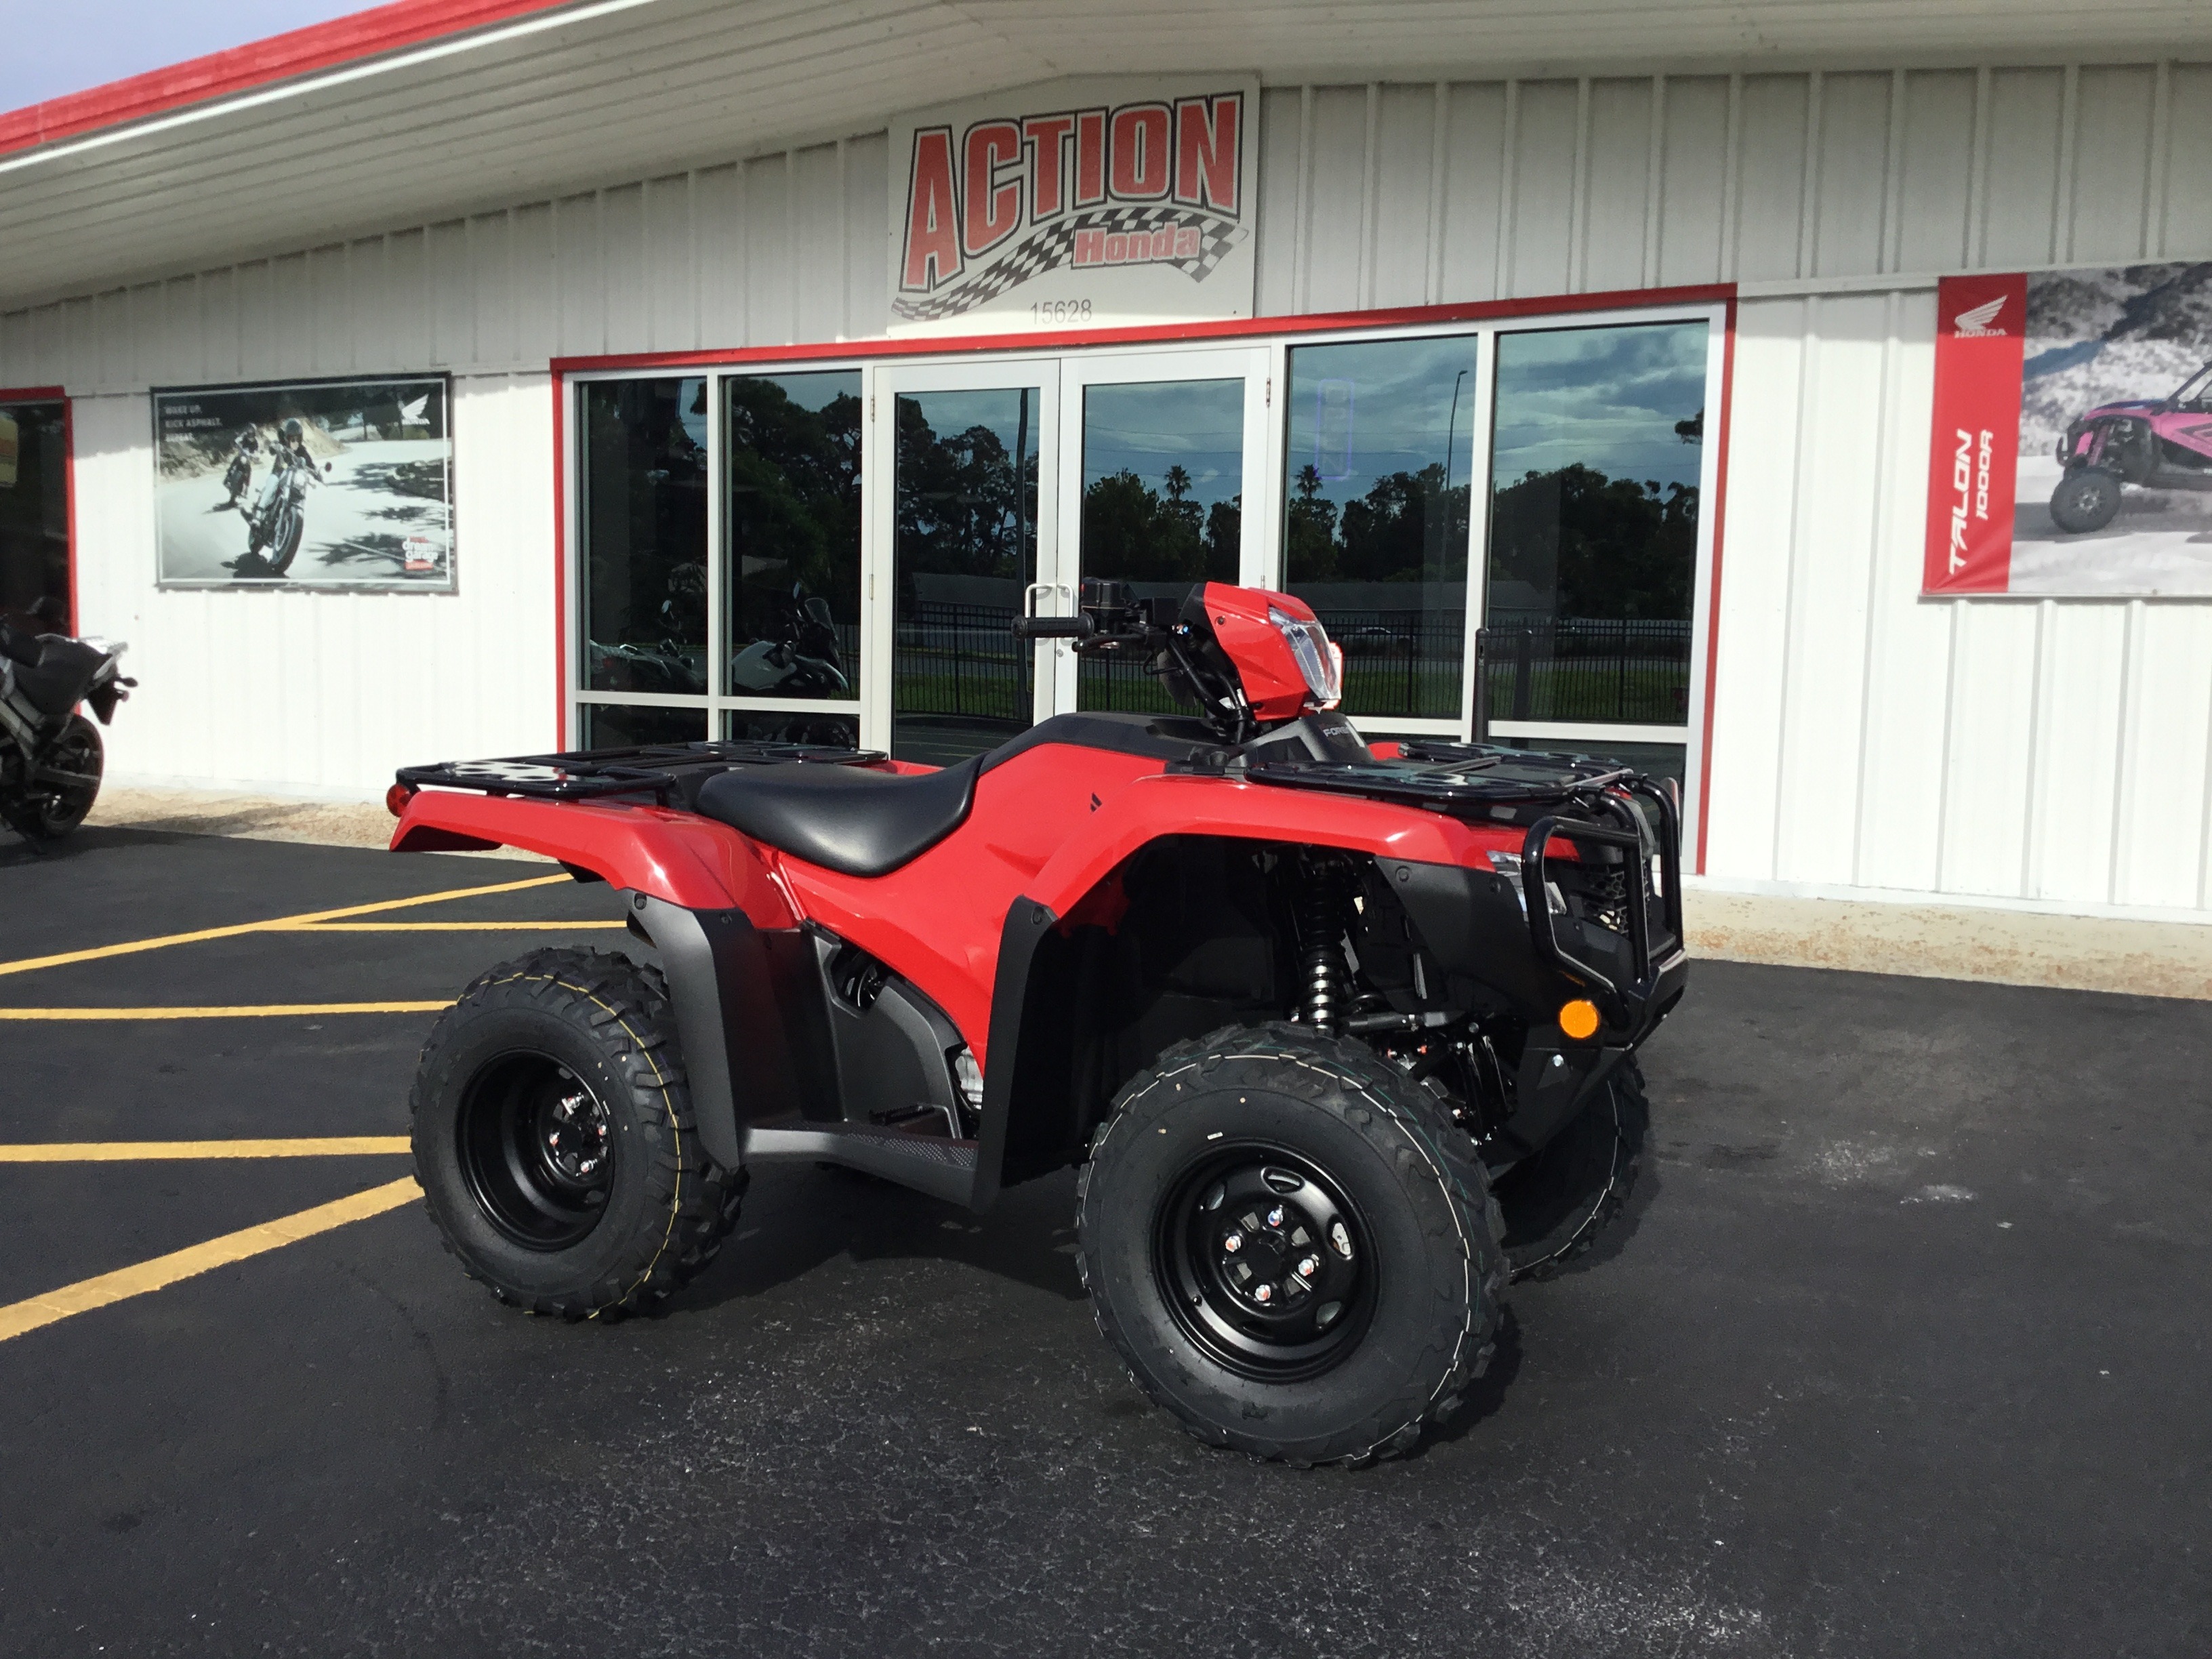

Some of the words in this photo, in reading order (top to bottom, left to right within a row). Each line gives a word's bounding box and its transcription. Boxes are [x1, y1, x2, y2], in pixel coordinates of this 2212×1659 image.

[900, 91, 1244, 293] ACTION
[1072, 221, 1202, 268] Honda
[1030, 299, 1092, 325] 15628
[1954, 328, 2007, 339] HONDA
[1948, 428, 1973, 575] TALON
[1975, 429, 1994, 521] 1000R
